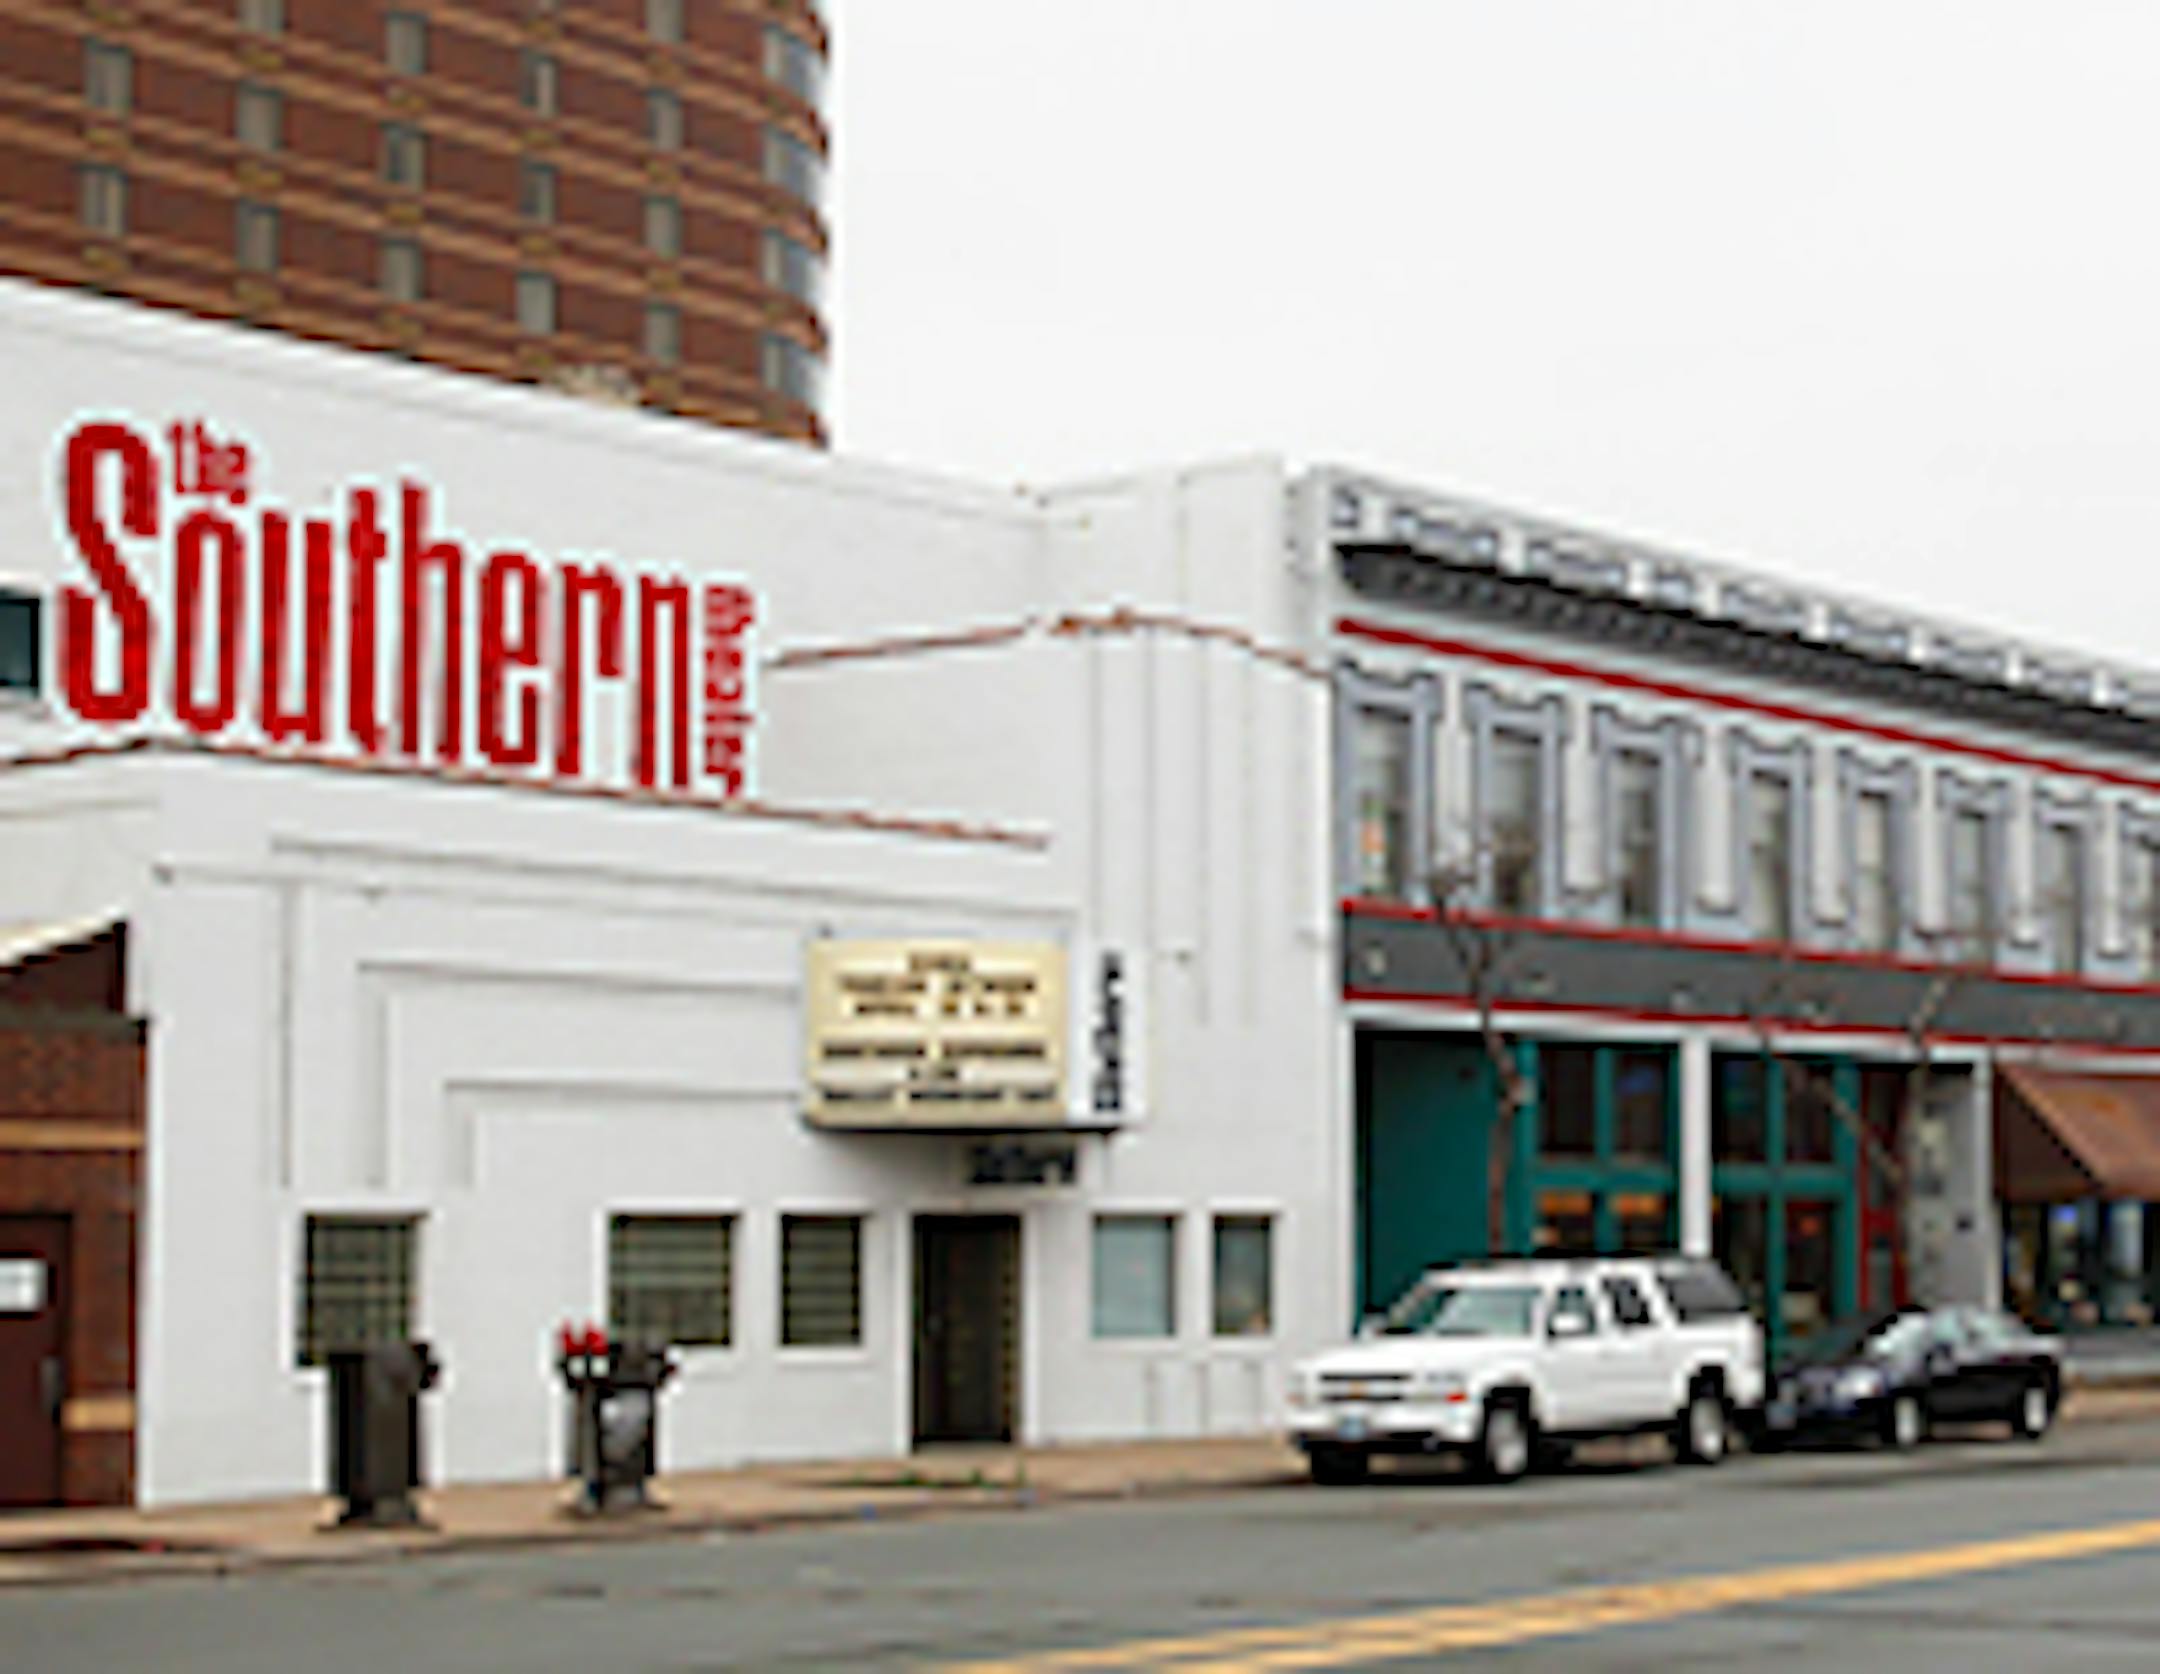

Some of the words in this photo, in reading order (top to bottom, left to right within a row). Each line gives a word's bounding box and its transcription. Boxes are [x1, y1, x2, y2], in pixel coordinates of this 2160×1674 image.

[166, 420, 249, 505] the
[58, 420, 690, 792] Southern
[703, 584, 757, 798] theater
